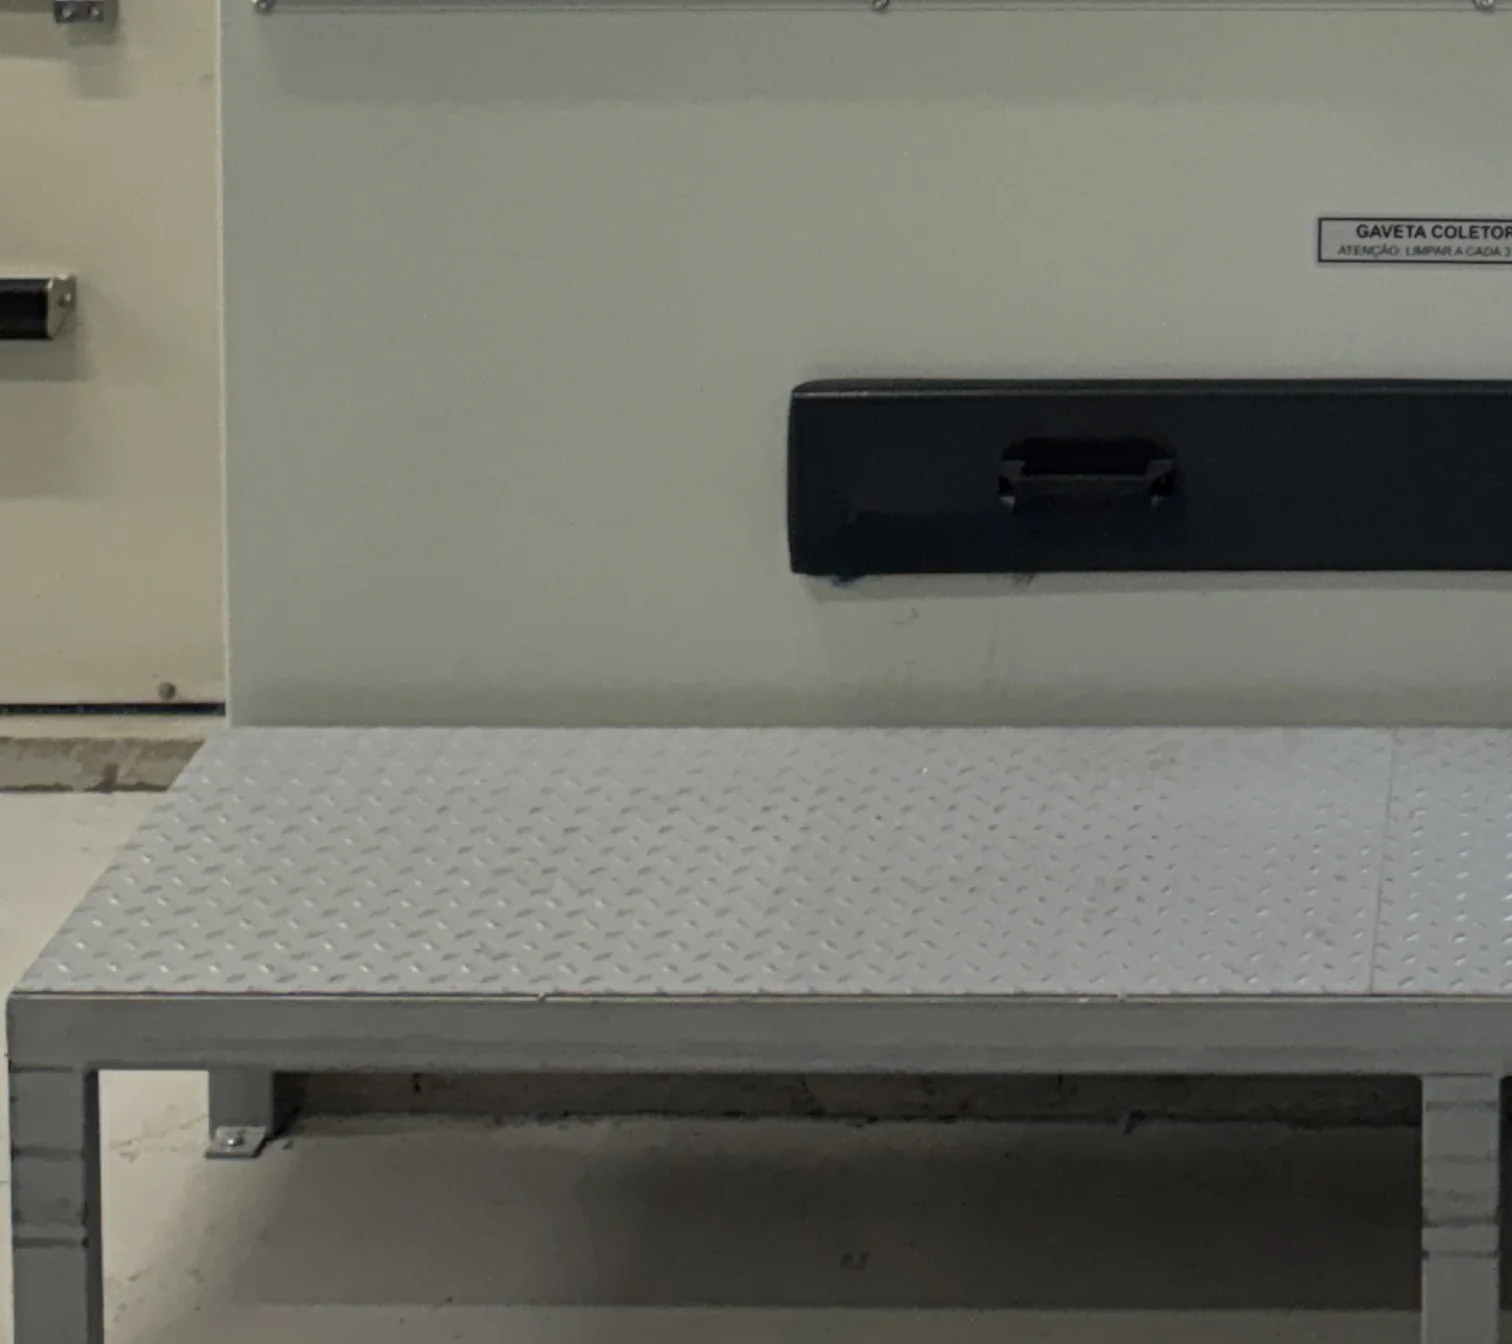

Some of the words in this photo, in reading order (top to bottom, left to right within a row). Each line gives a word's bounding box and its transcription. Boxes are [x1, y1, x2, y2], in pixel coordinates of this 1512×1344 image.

[1356, 223, 1427, 240] GAVETA
[1405, 245, 1452, 257] LIMPAR
[1465, 246, 1501, 258] CADA
